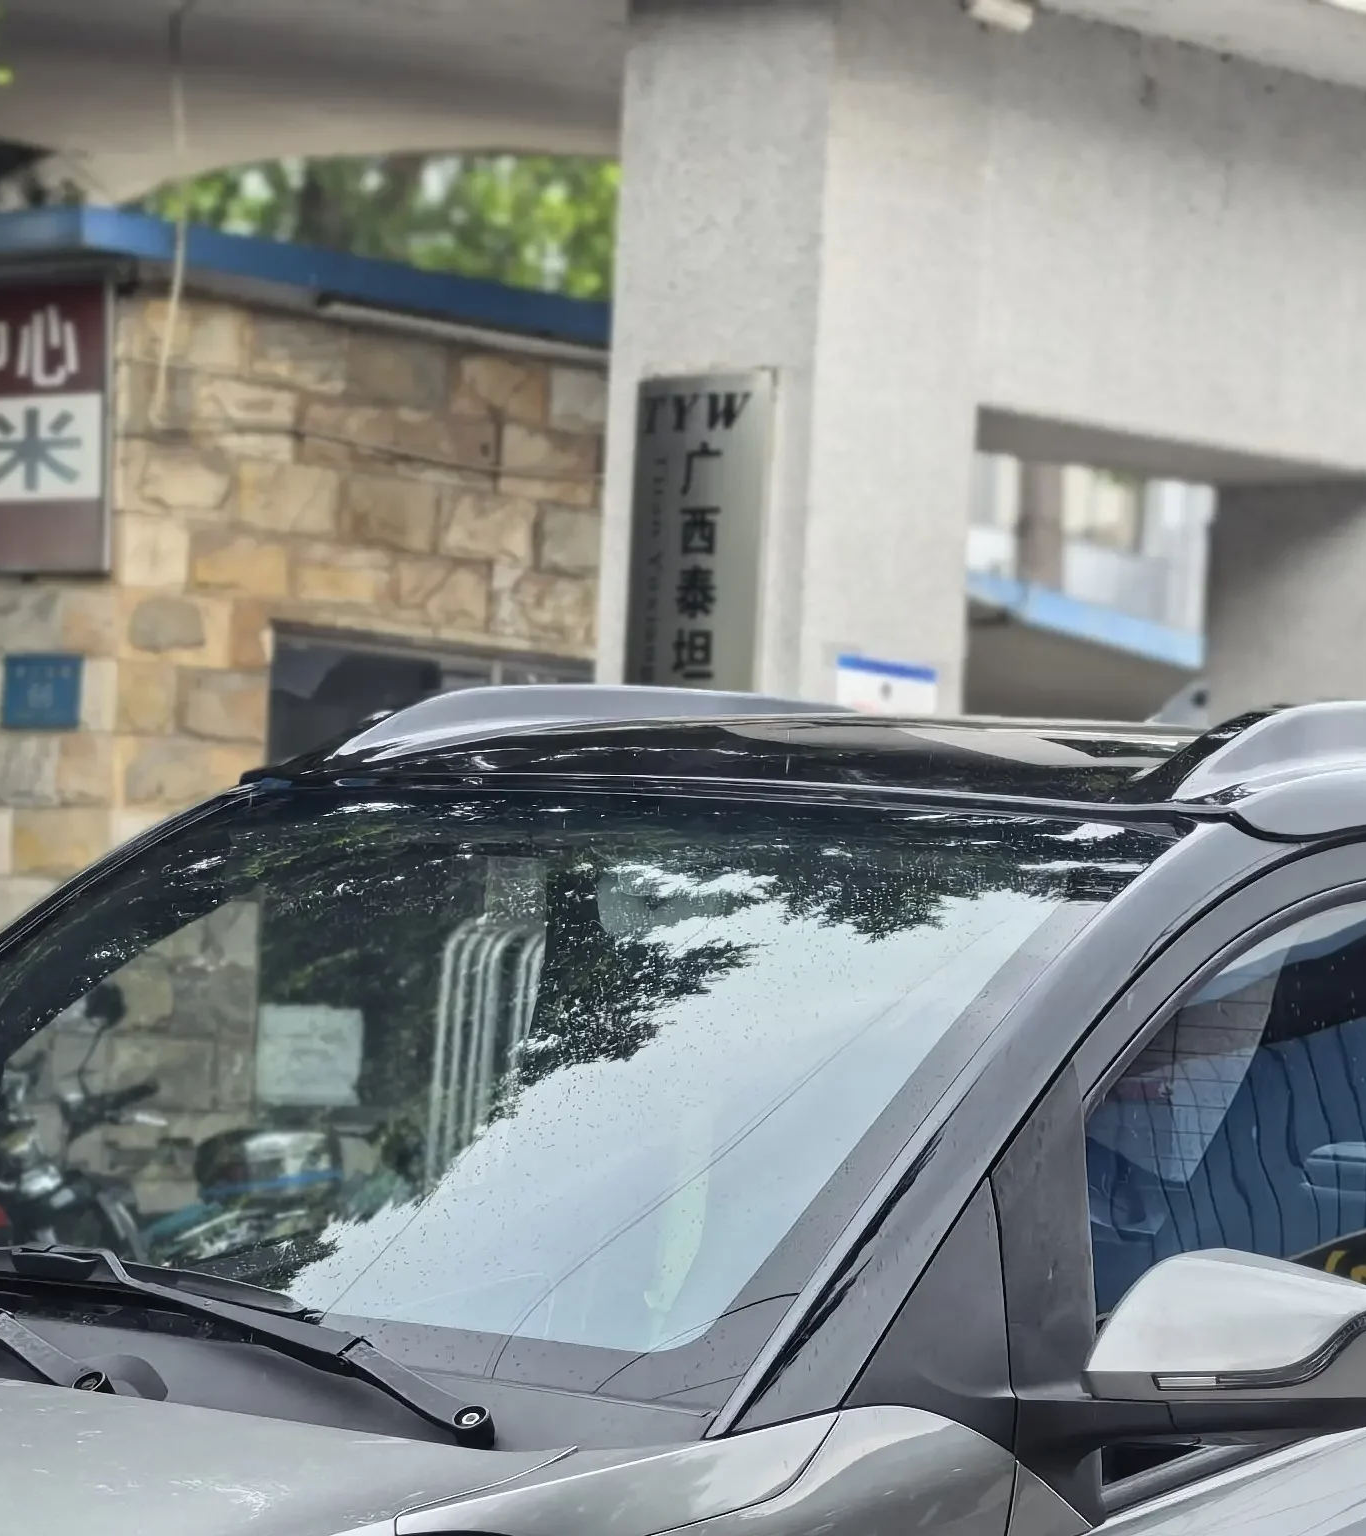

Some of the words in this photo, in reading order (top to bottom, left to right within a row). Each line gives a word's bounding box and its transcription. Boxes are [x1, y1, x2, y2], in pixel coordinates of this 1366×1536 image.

[641, 391, 751, 435] TYW
[672, 441, 722, 680] 广西泰坦
